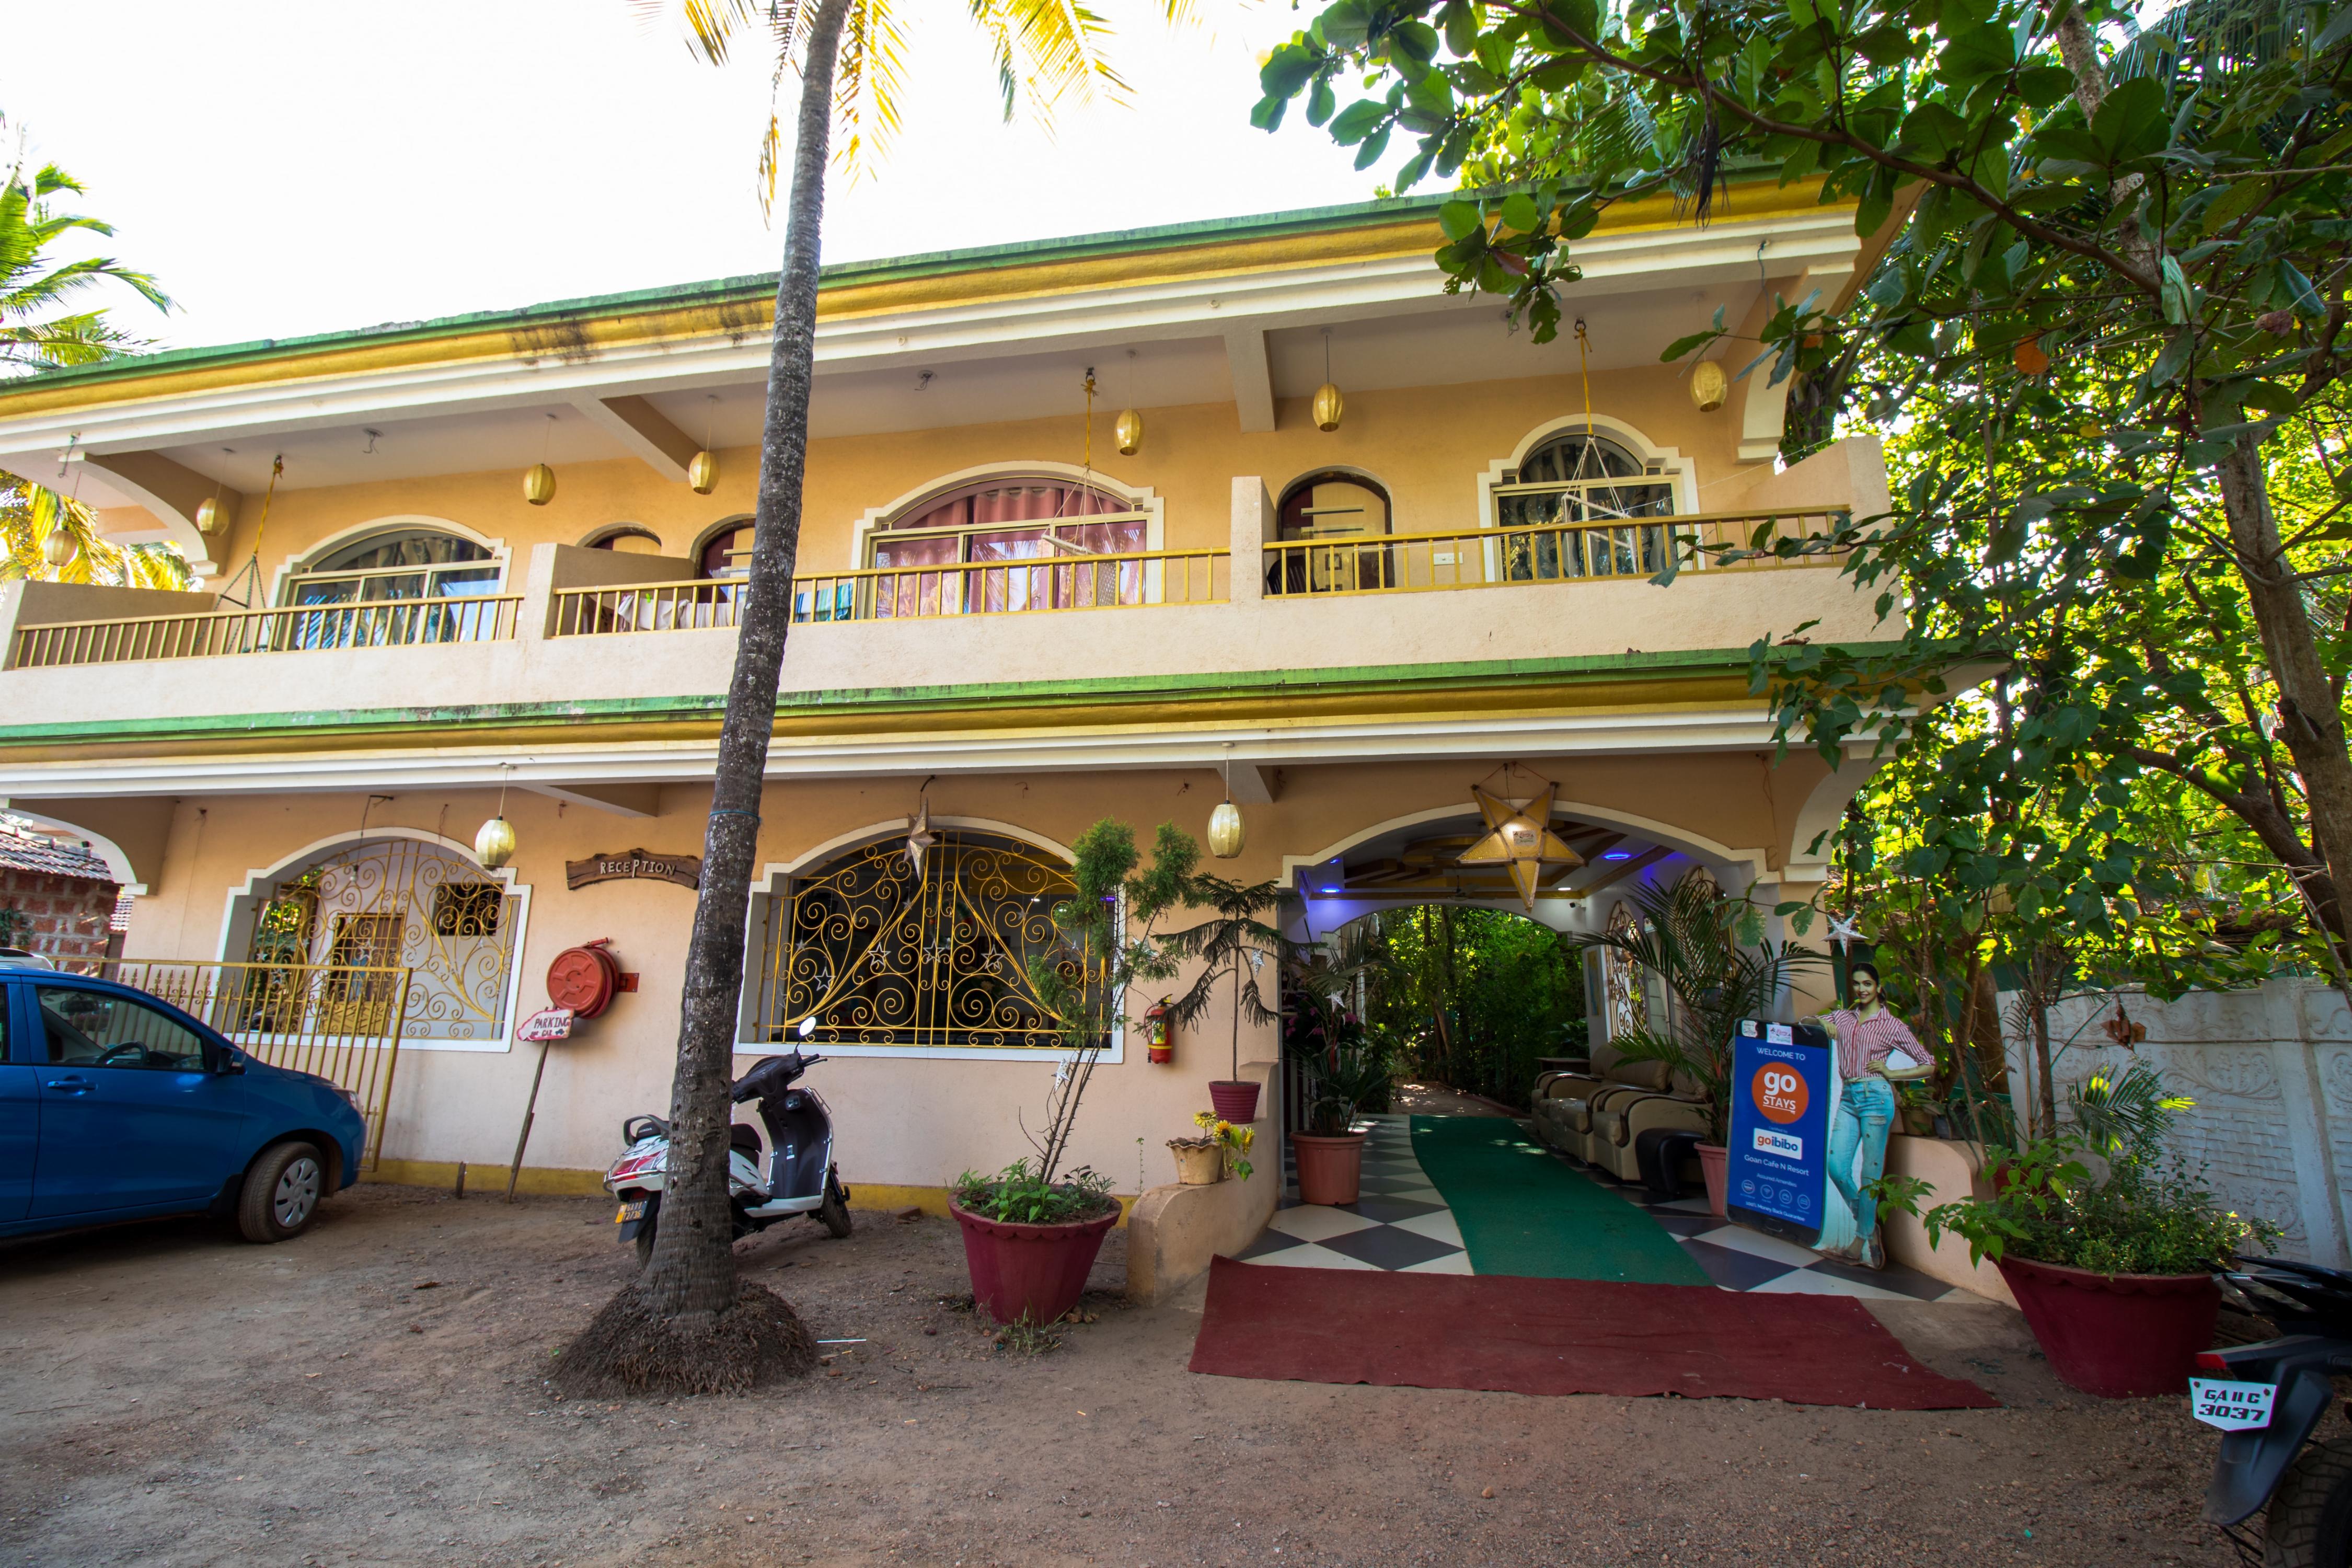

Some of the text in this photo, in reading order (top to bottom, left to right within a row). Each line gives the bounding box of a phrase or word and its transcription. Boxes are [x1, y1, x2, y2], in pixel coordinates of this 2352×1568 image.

[600, 859, 676, 878] RECEPTION
[534, 1017, 570, 1029] PARKING
[1757, 1047, 1806, 1061] WELCOME TO
[1764, 1071, 1796, 1096] go
[1763, 1095, 1796, 1110] STAYS
[1757, 1135, 1798, 1151] goibibo
[1744, 1154, 1762, 1165] Goan
[1763, 1159, 1779, 1169] Cafe
[1787, 1164, 1809, 1176] Resort
[2198, 1403, 2265, 1422] 3037
